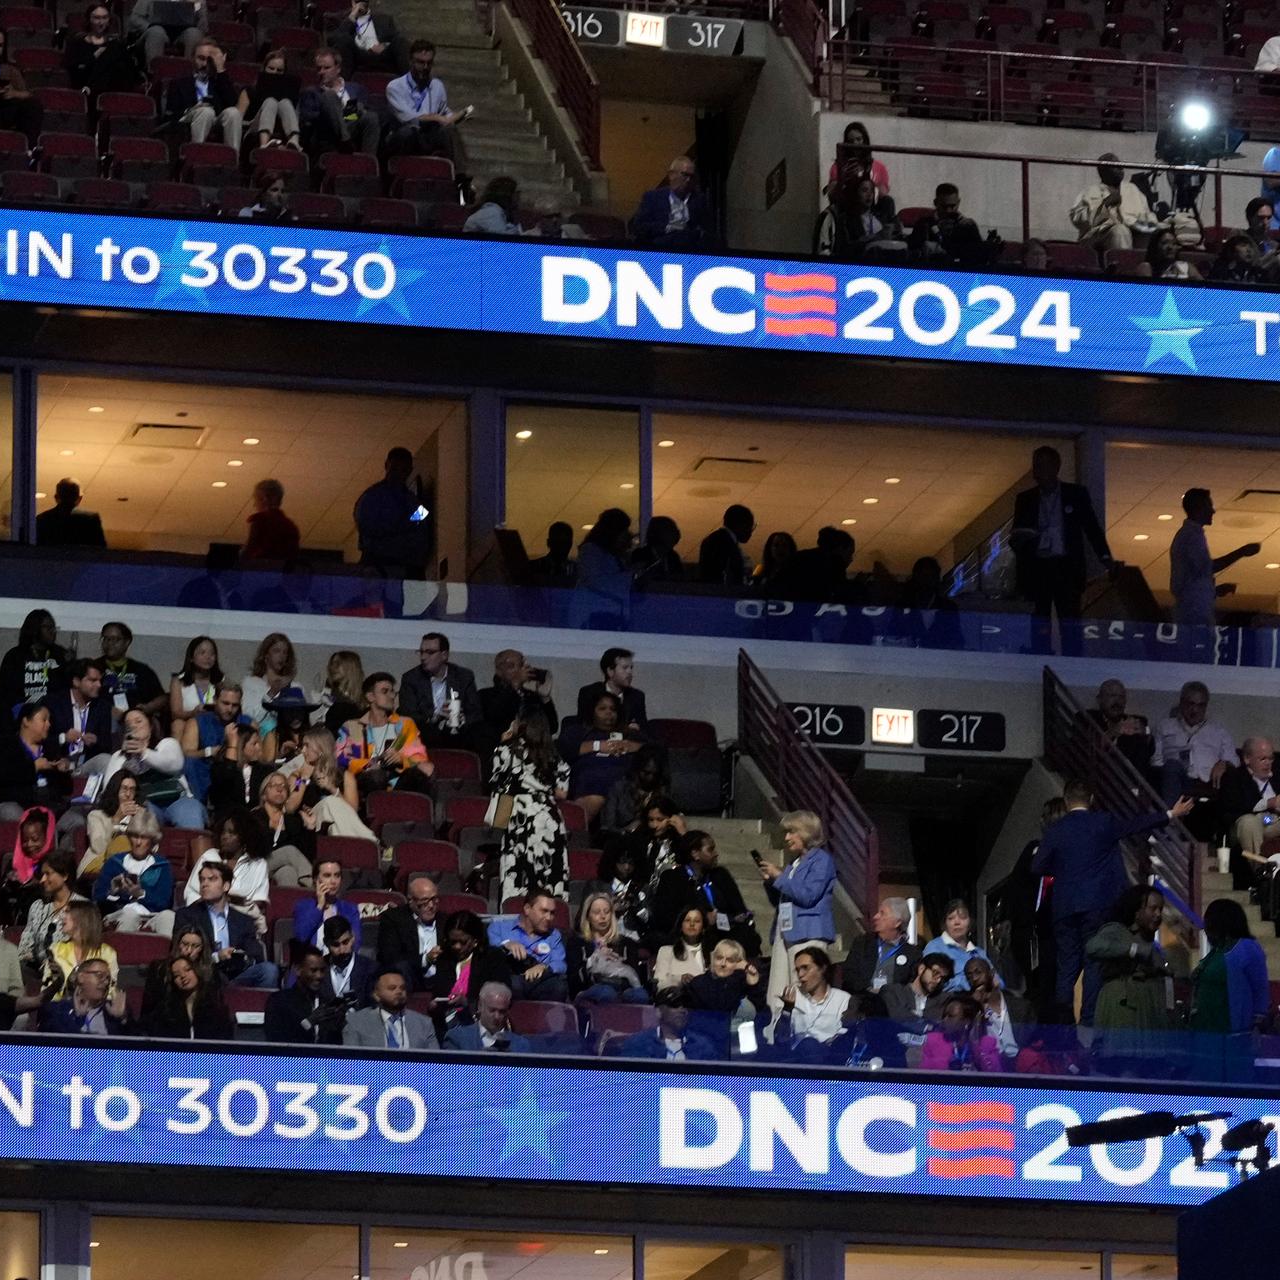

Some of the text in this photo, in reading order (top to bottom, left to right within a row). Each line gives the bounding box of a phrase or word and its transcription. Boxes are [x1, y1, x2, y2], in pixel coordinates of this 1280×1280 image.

[562, 11, 603, 38] 316
[630, 17, 661, 36] EXIT
[687, 21, 726, 49] 317
[95, 237, 161, 284] to
[181, 240, 397, 299] 30330
[541, 255, 1081, 353] DNC 2024
[792, 706, 844, 736] 216
[876, 713, 910, 737] EXIT
[940, 714, 982, 744] 217
[62, 1074, 142, 1133] to
[165, 1076, 429, 1144] 30330
[658, 1086, 918, 1179] DNC
